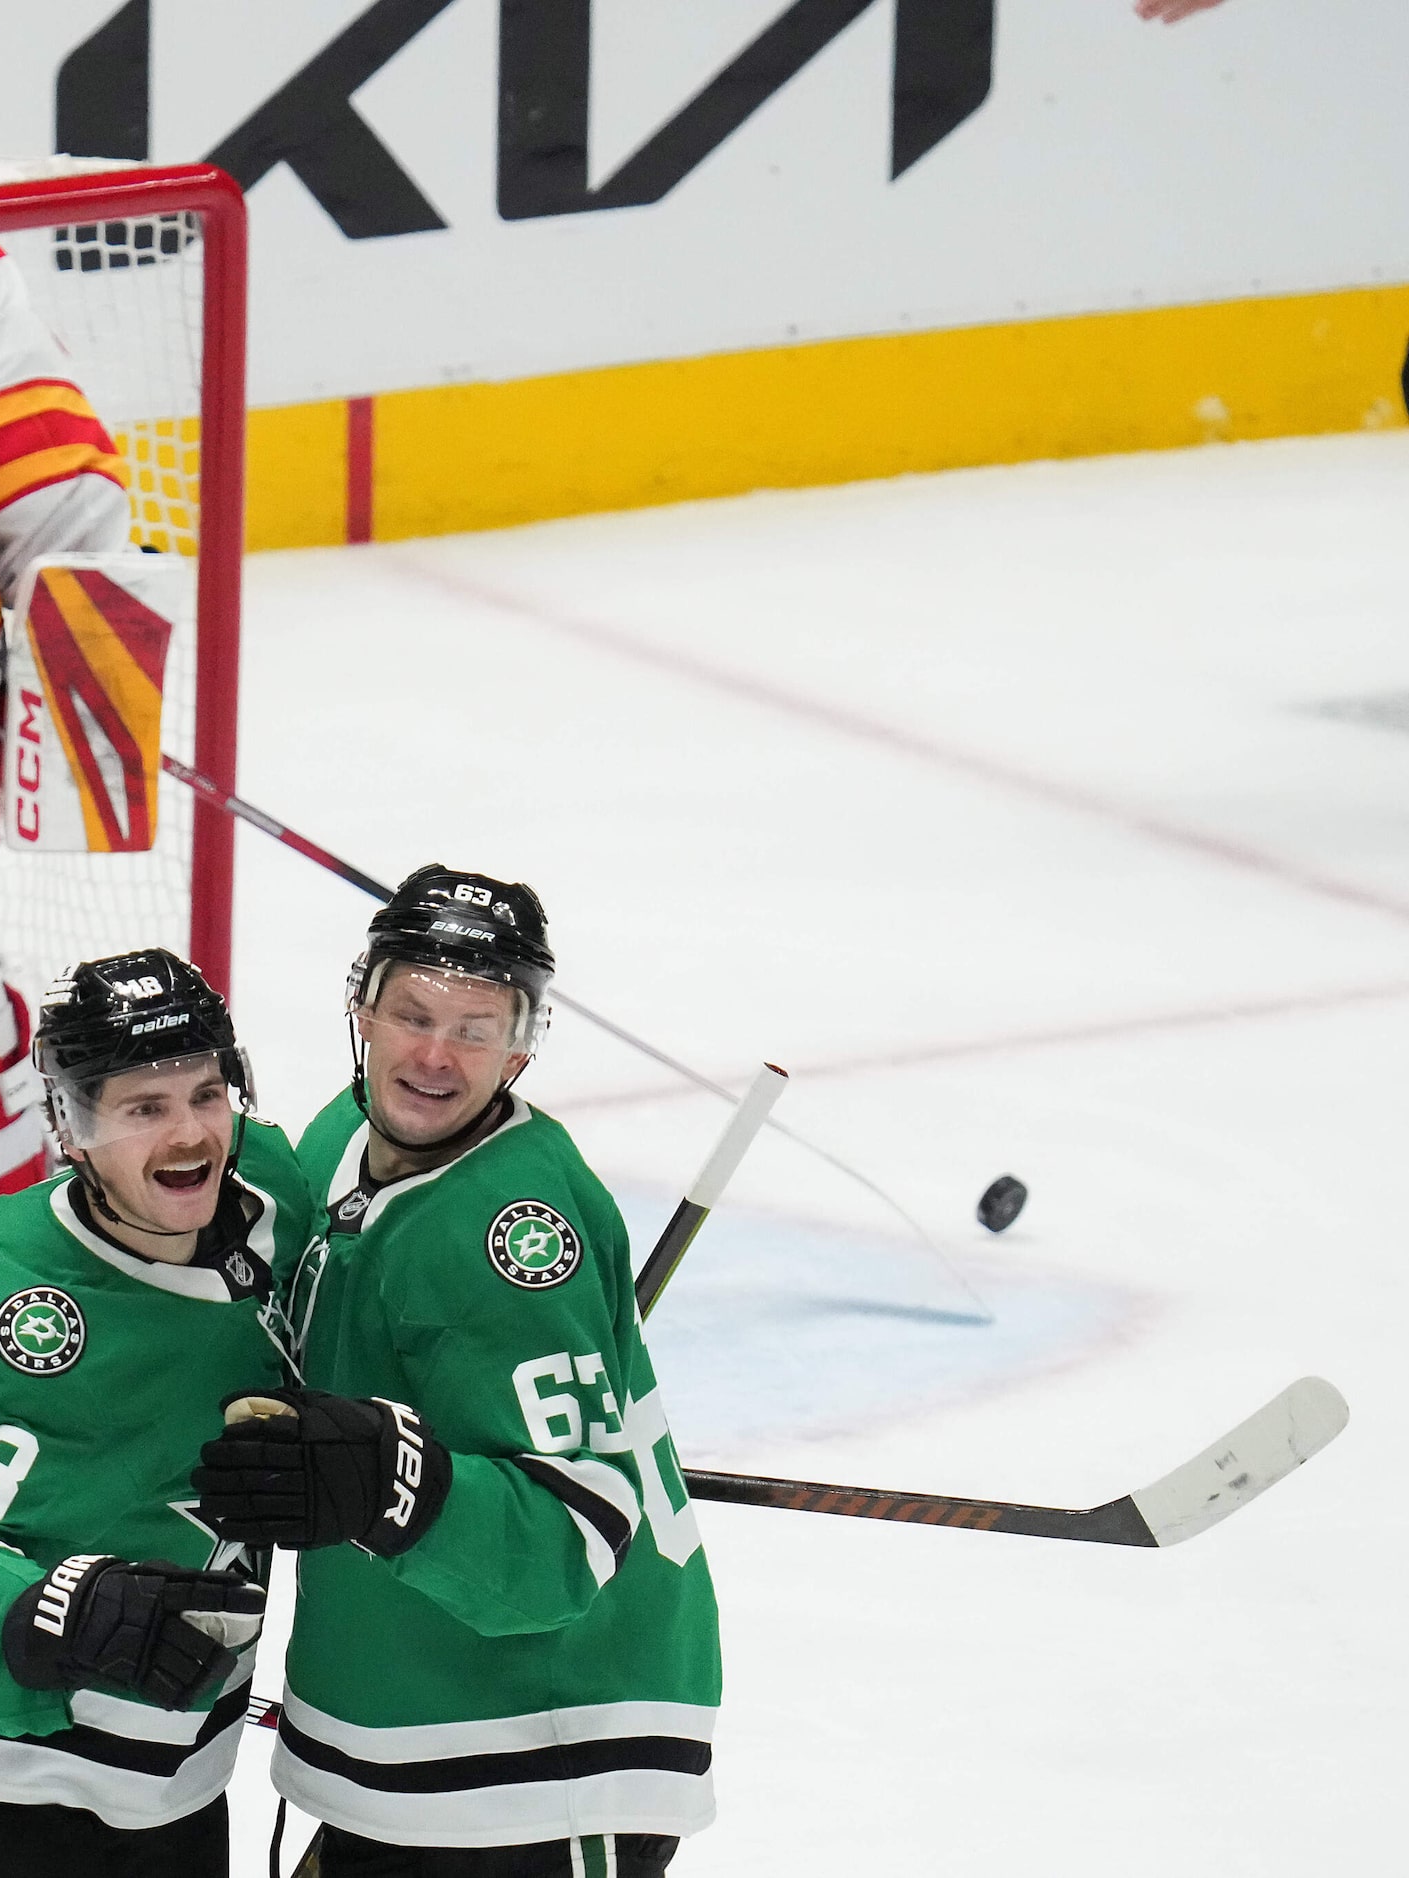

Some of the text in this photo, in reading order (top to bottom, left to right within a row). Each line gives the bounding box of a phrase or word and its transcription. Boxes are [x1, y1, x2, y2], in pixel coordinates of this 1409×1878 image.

[18, 689, 42, 842] CCM
[454, 883, 492, 907] 63
[494, 1206, 567, 1247] DALLAS
[507, 1249, 574, 1281] STARS
[11, 1292, 80, 1344] DALLAS
[0, 1326, 62, 1368] STARS
[370, 1396, 424, 1527] UER
[33, 1554, 116, 1637] WAR
